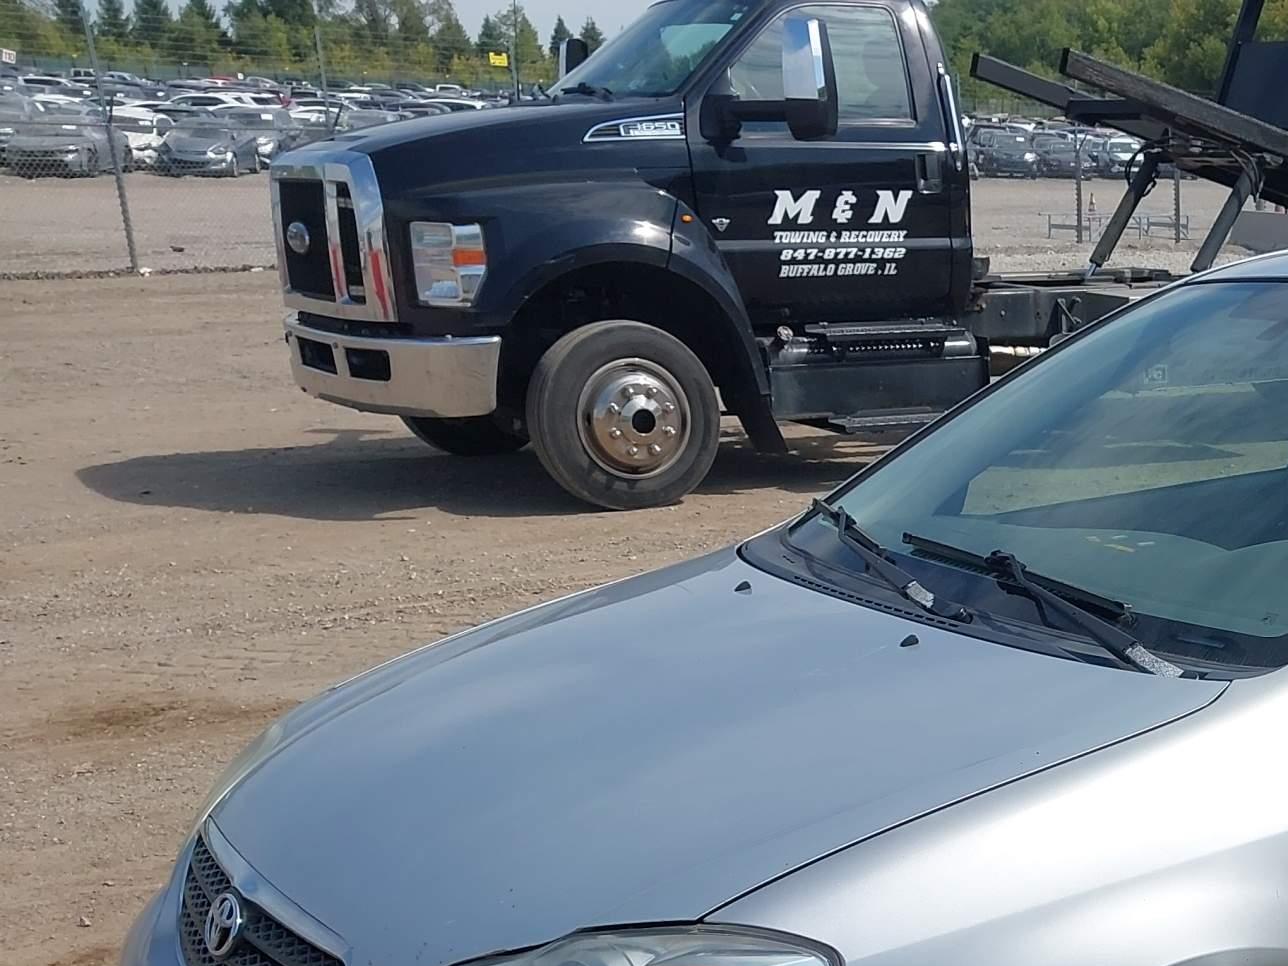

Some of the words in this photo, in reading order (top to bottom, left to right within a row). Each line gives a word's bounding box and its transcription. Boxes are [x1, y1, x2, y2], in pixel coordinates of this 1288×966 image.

[767, 190, 821, 225] M
[832, 190, 857, 224] &
[868, 190, 913, 224] N
[773, 231, 828, 244] TOWING
[840, 230, 907, 243] RECOVERY
[780, 248, 906, 261] 847-877-1362
[779, 264, 834, 278] BUFFALO
[884, 263, 898, 275] IL
